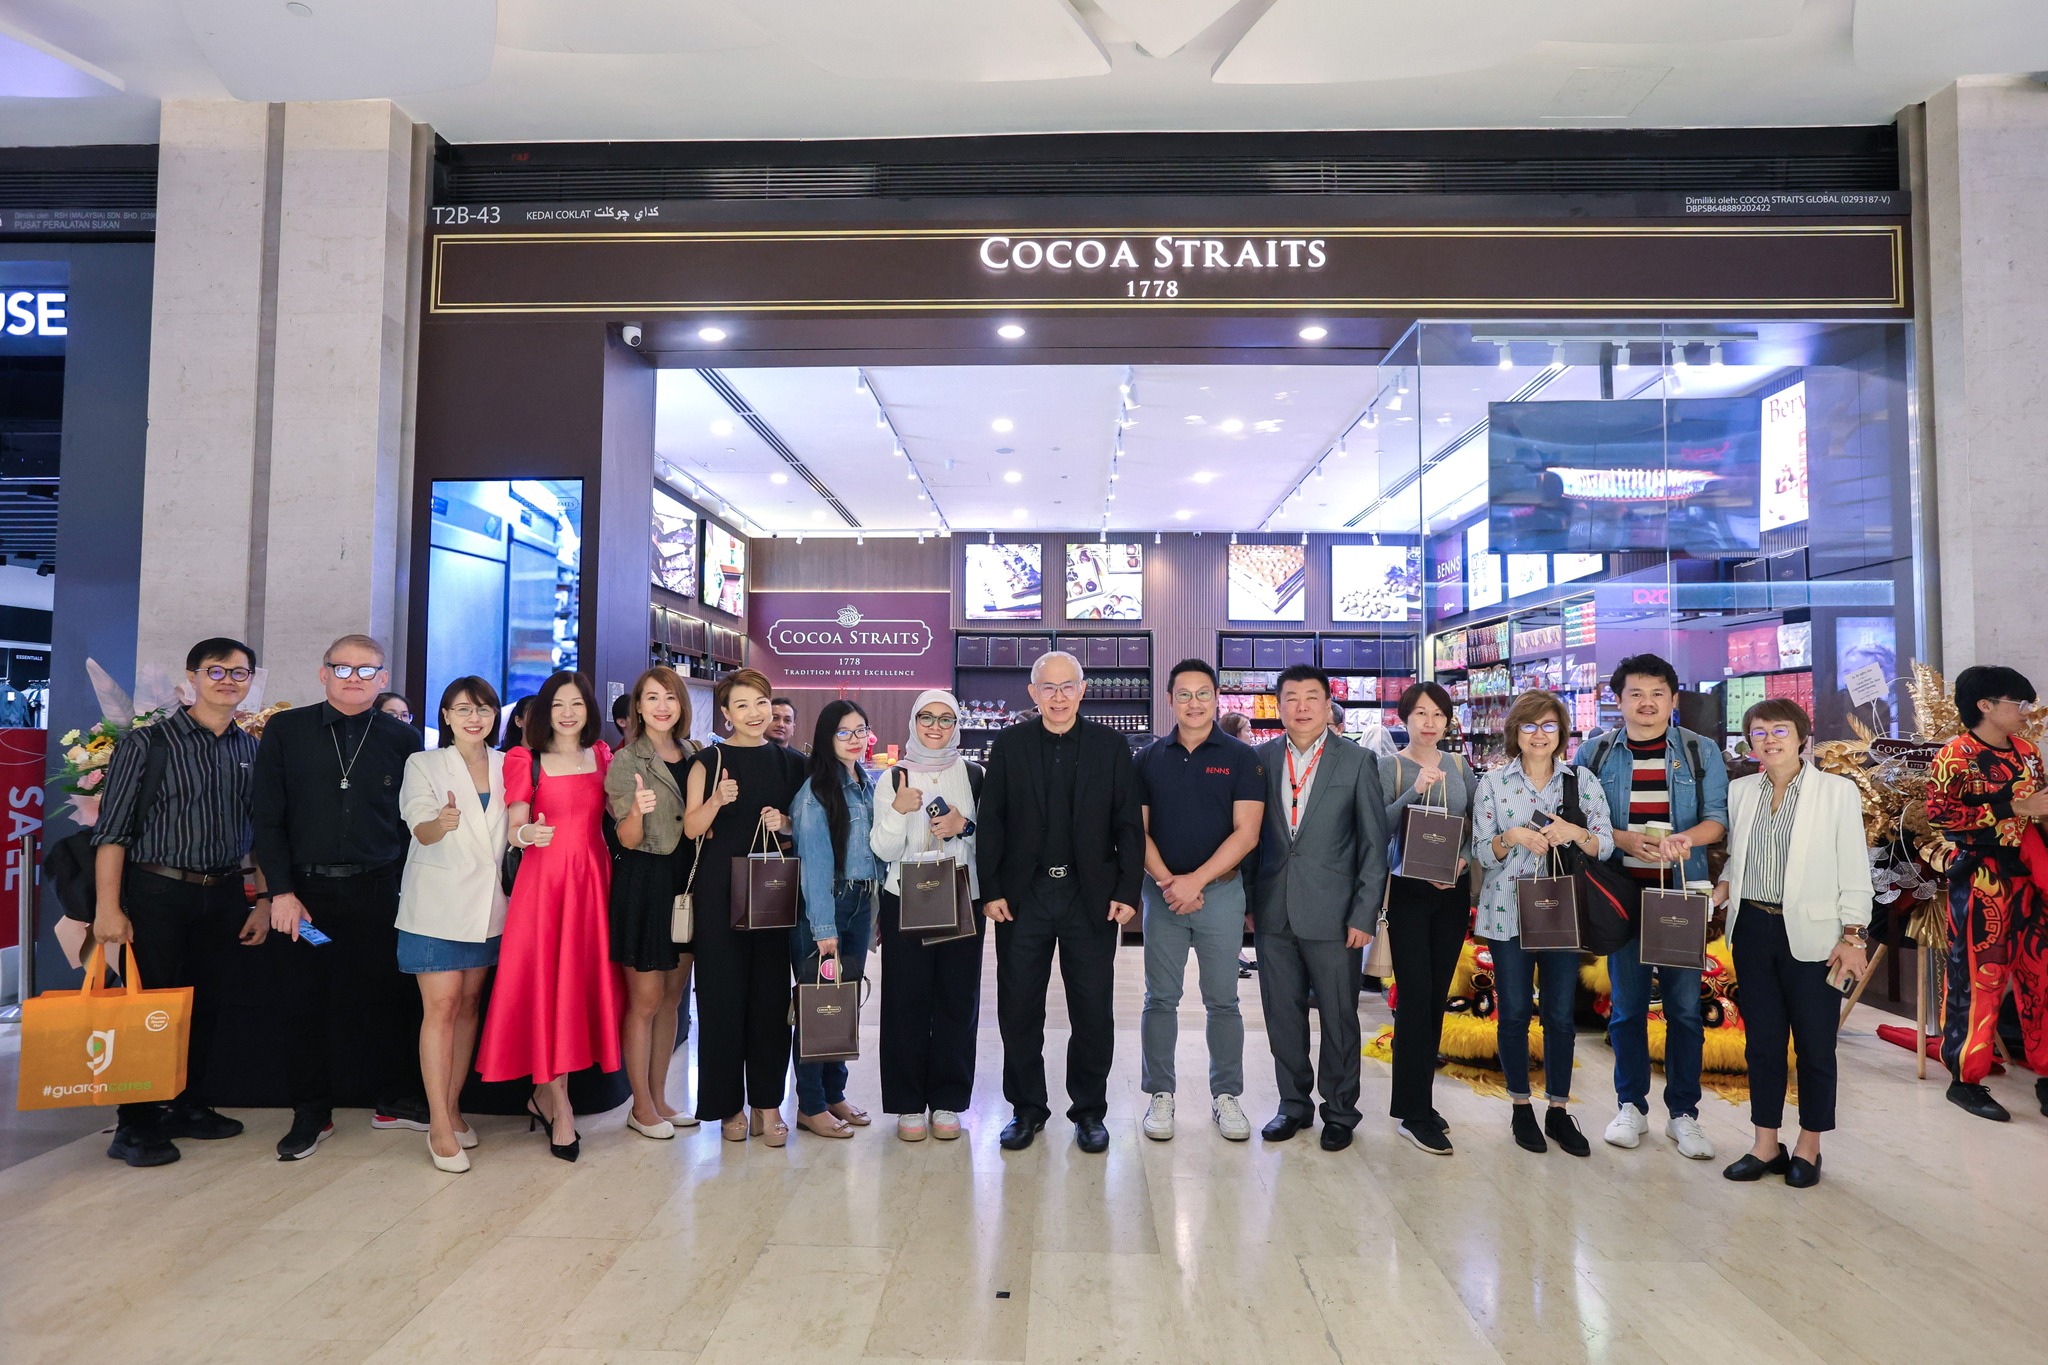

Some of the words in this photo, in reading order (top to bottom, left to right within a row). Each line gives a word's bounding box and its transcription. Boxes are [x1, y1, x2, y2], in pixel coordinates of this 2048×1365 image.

[1685, 196, 1716, 204] Dimiliki
[1739, 196, 1770, 204] COCOA
[1771, 196, 1804, 204] STRAITS
[1805, 195, 1839, 204] GLOBAL
[1841, 195, 1890, 204] (0293187-V)
[69, 211, 106, 220] (MALAYSIA)
[432, 206, 501, 224] T2B-43
[526, 210, 554, 220] KEDAI
[555, 210, 591, 219] COKLAT
[14, 221, 40, 229] PUSAT
[43, 220, 90, 229] PERALATAN
[92, 221, 120, 229] SUKAN
[980, 236, 1139, 269] COCOA
[1154, 236, 1326, 268] STRAITS
[1126, 280, 1179, 297] 1778
[0, 291, 68, 336] SE
[1437, 555, 1461, 579] BENNS
[779, 630, 843, 645] COCOA
[849, 630, 919, 645] STRAITS
[15, 654, 43, 662] ESSENTIALS
[839, 658, 860, 666] 1778
[1877, 744, 1914, 756] COCOA
[1205, 766, 1230, 775] BENNS
